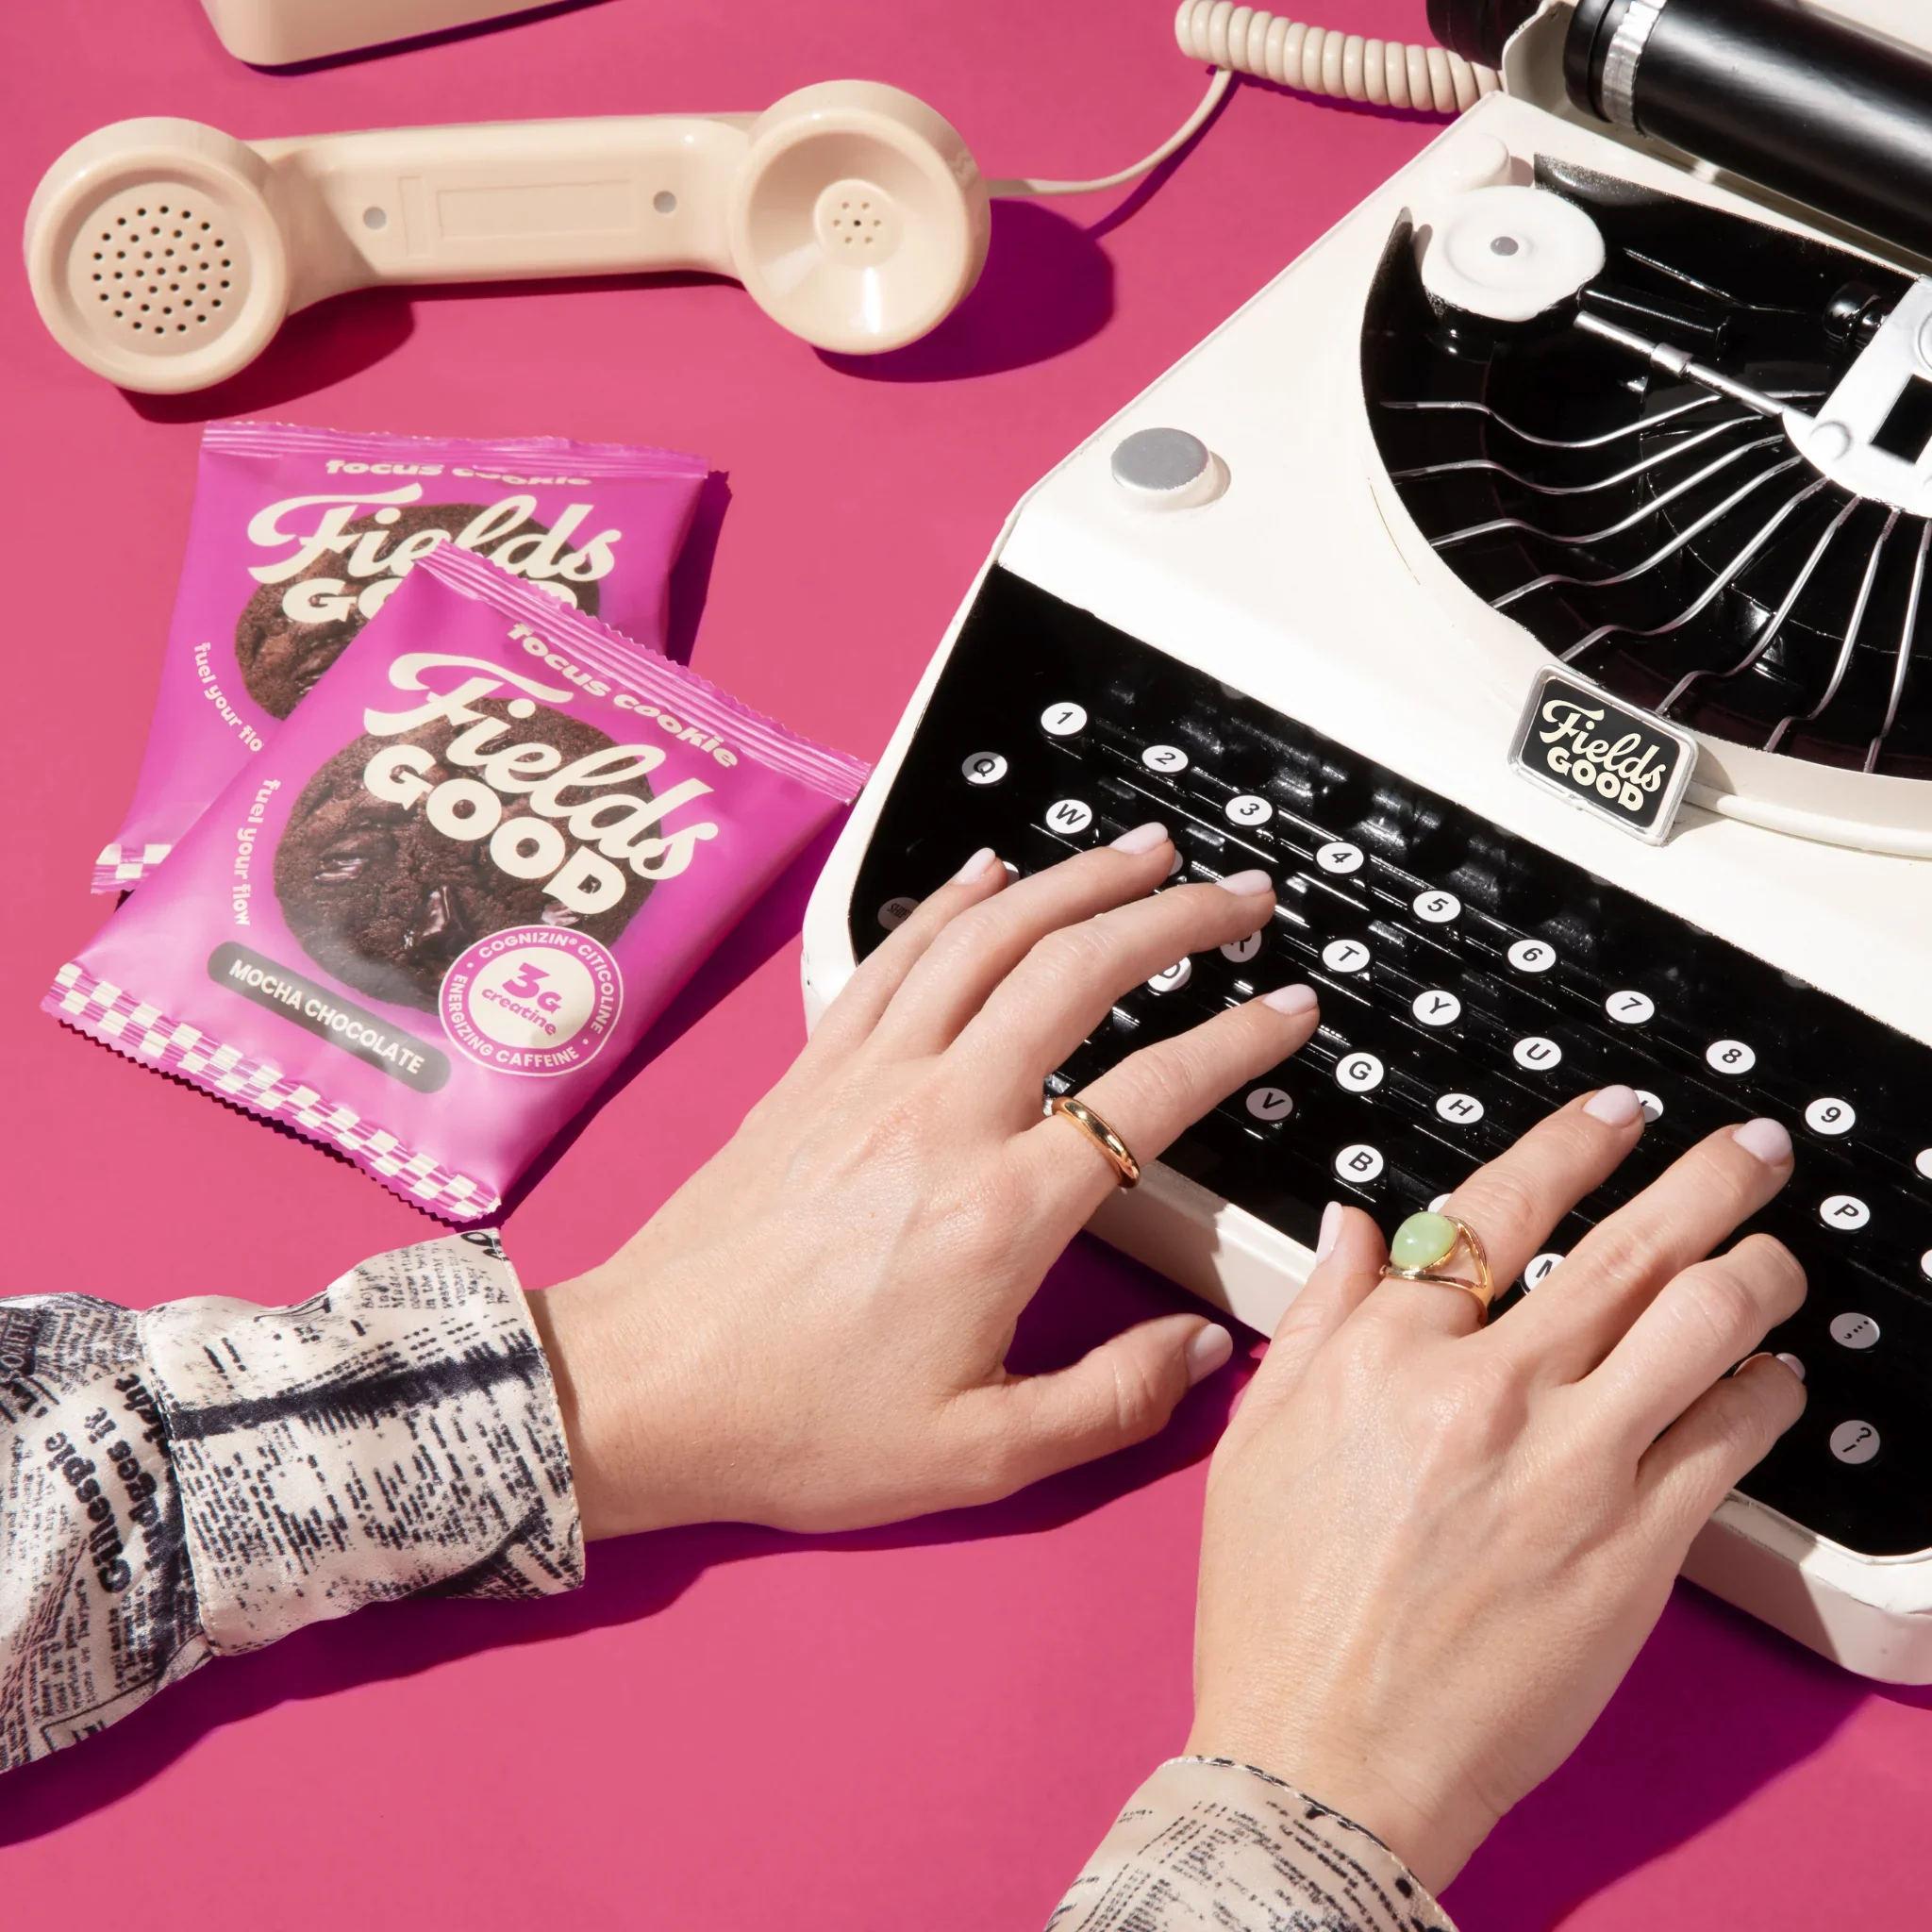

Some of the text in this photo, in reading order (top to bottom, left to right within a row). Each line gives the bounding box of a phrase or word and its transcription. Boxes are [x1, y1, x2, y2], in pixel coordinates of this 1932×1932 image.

[326, 459, 444, 475] focus
[193, 641, 265, 753] fuel your flo
[508, 623, 738, 768] focus cookie
[1058, 711, 1074, 724] 1
[1539, 699, 1667, 792] Fields
[363, 652, 719, 881] Fields
[973, 758, 995, 776] Q
[1155, 752, 1176, 765] 2
[1546, 746, 1644, 811] GOOD
[1056, 804, 1086, 825] W
[1240, 803, 1260, 816] 3
[363, 743, 626, 915] GOOD
[232, 778, 281, 926] fuel your flow
[1330, 851, 1353, 864] 4
[1427, 898, 1449, 912] 5
[1339, 945, 1359, 961] T
[1522, 947, 1543, 961] 6
[502, 961, 562, 1015] 3G
[577, 944, 613, 1034] CITICOLINE
[481, 988, 558, 1037] creatine
[1429, 996, 1451, 1014] Y
[1621, 997, 1642, 1011] 7
[229, 958, 425, 1074] MOCHA CHOCOLATE
[448, 974, 580, 1068] ENERGIZING CAFFEINE
[1526, 1042, 1552, 1061] U
[1722, 1048, 1742, 1064] 8
[1349, 1060, 1372, 1080] G
[1261, 1091, 1287, 1110] V
[1448, 1099, 1474, 1117] H
[1821, 1107, 1841, 1124] 9
[1348, 1151, 1374, 1172] B
[1833, 1203, 1859, 1217] P
[44, 1431, 132, 1593] Gillespie
